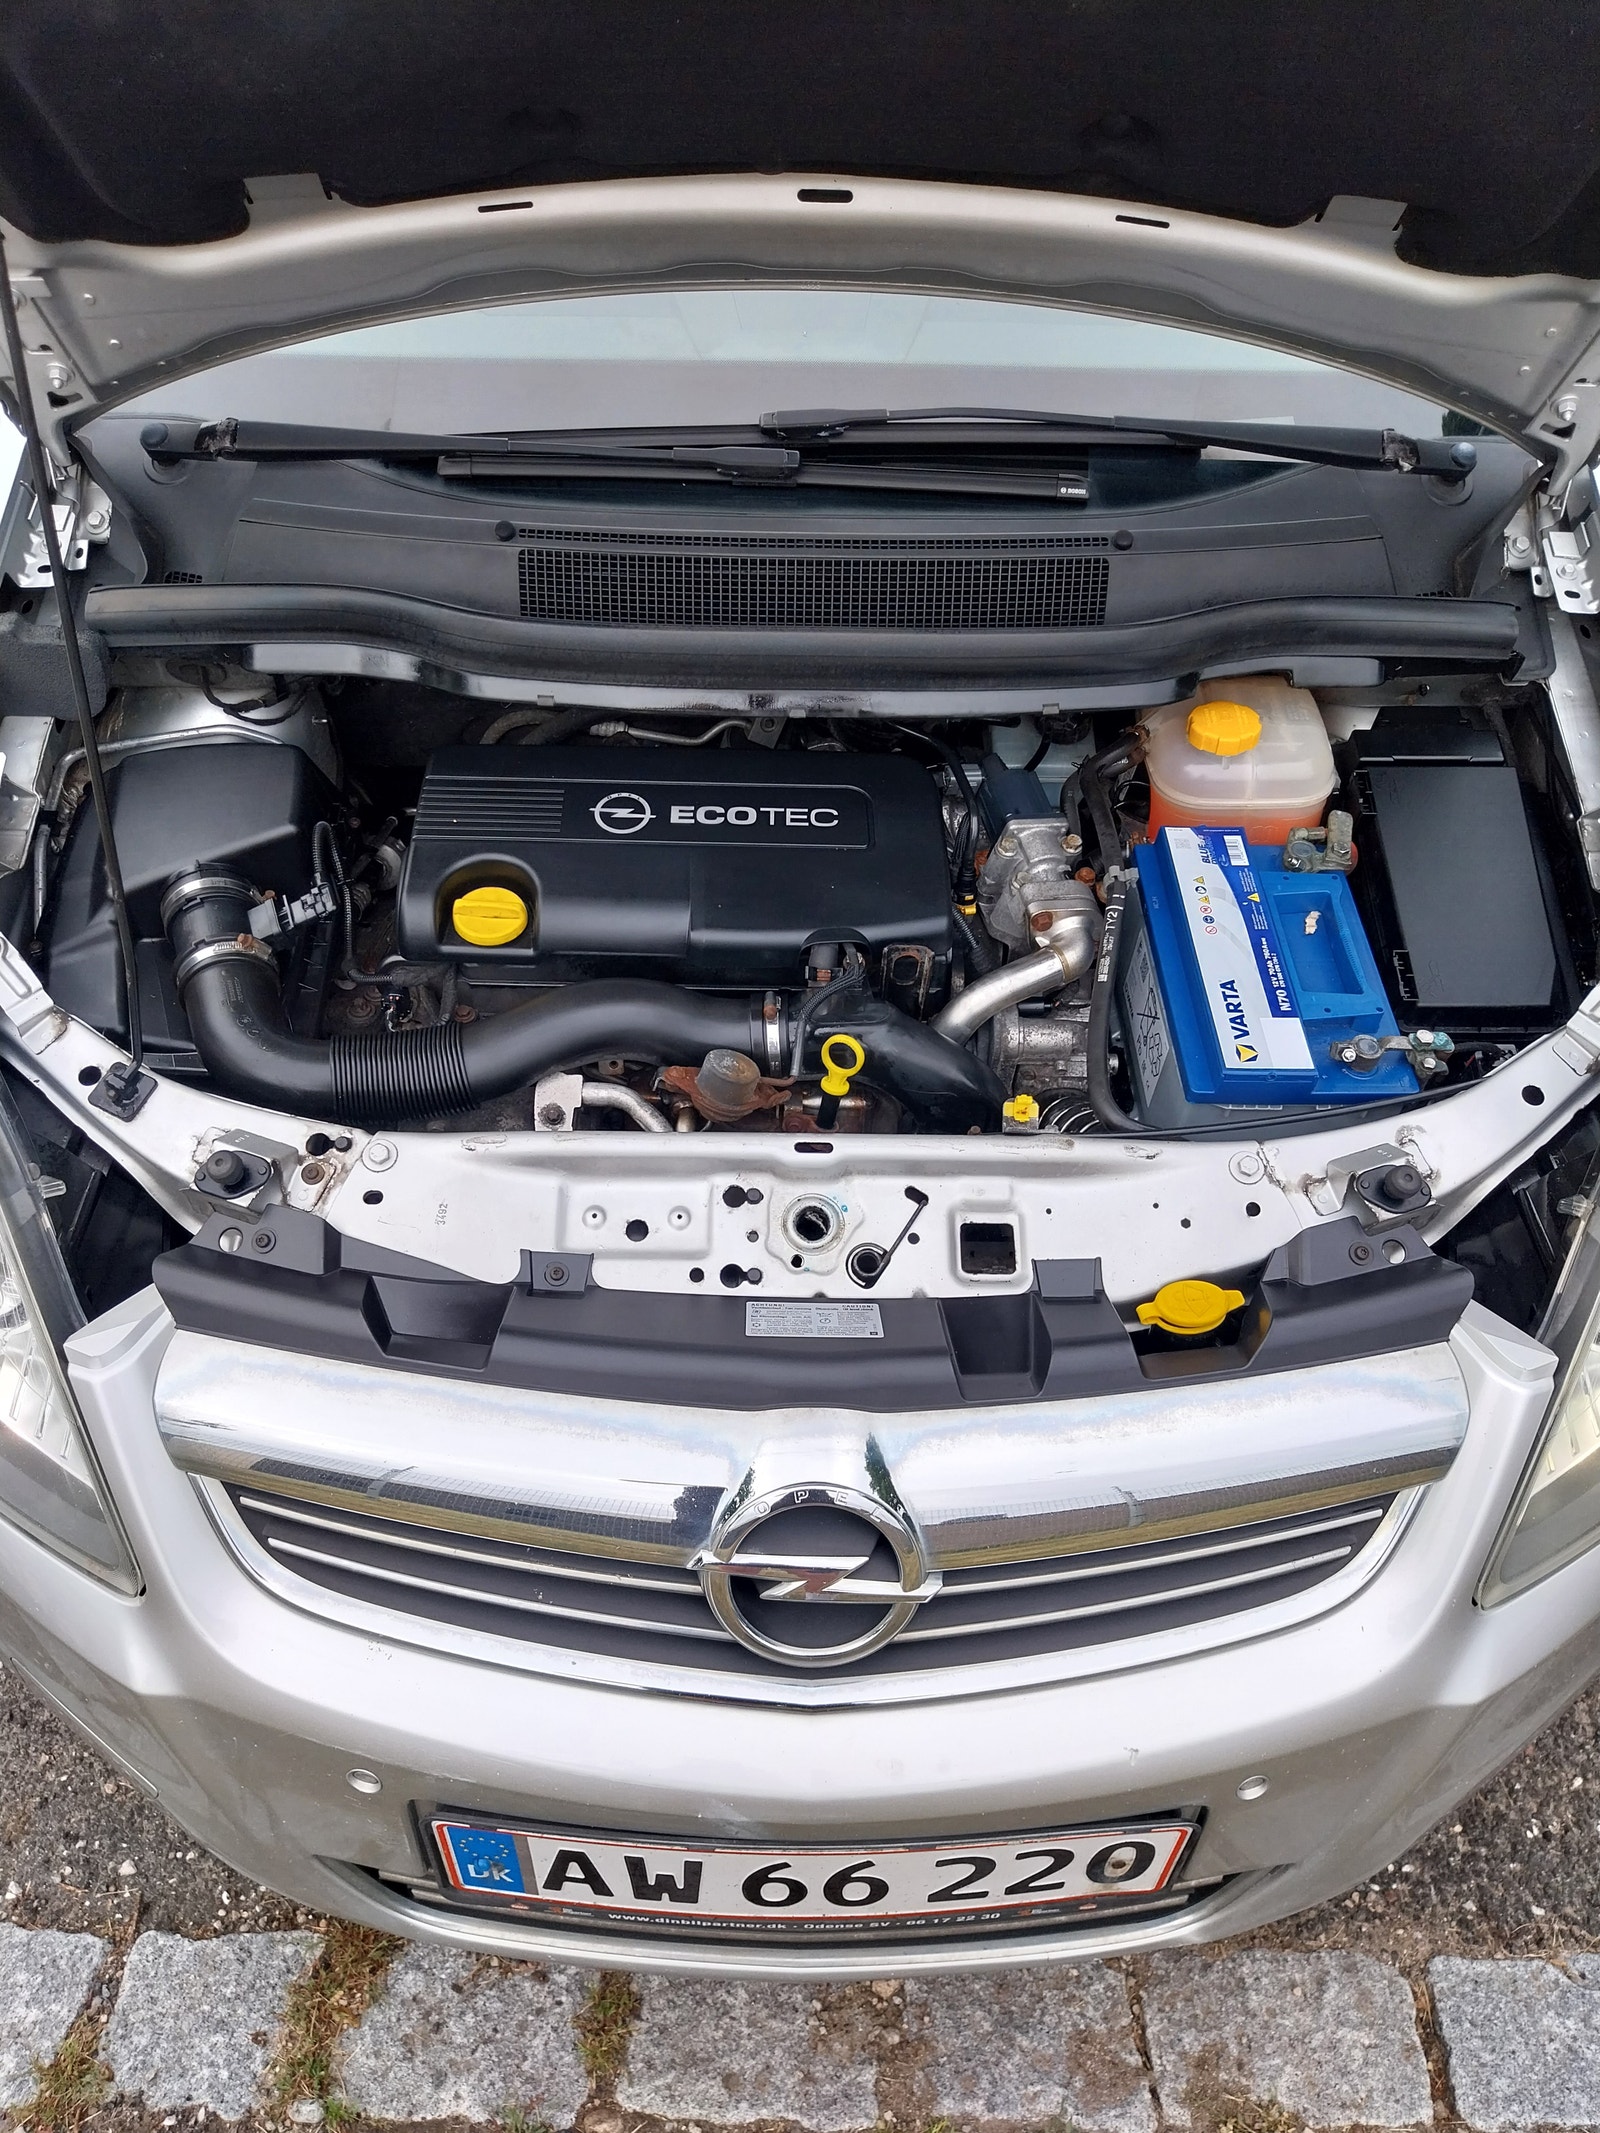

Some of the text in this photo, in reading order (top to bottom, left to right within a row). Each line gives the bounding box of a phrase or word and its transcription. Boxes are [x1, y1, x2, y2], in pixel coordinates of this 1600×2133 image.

[1067, 487, 1087, 495] BOSCH
[670, 805, 839, 827] ECOTEC
[1219, 979, 1250, 1040] VARTA
[1276, 989, 1293, 1011] N70
[754, 1490, 882, 1522] OPEL
[543, 1841, 1156, 1907] AW 66 220
[608, 1913, 787, 1929] www.dinbilpartner.dk
[932, 1917, 950, 1925] 17
[956, 1914, 976, 1922] 22
[981, 1912, 1001, 1920] 30
